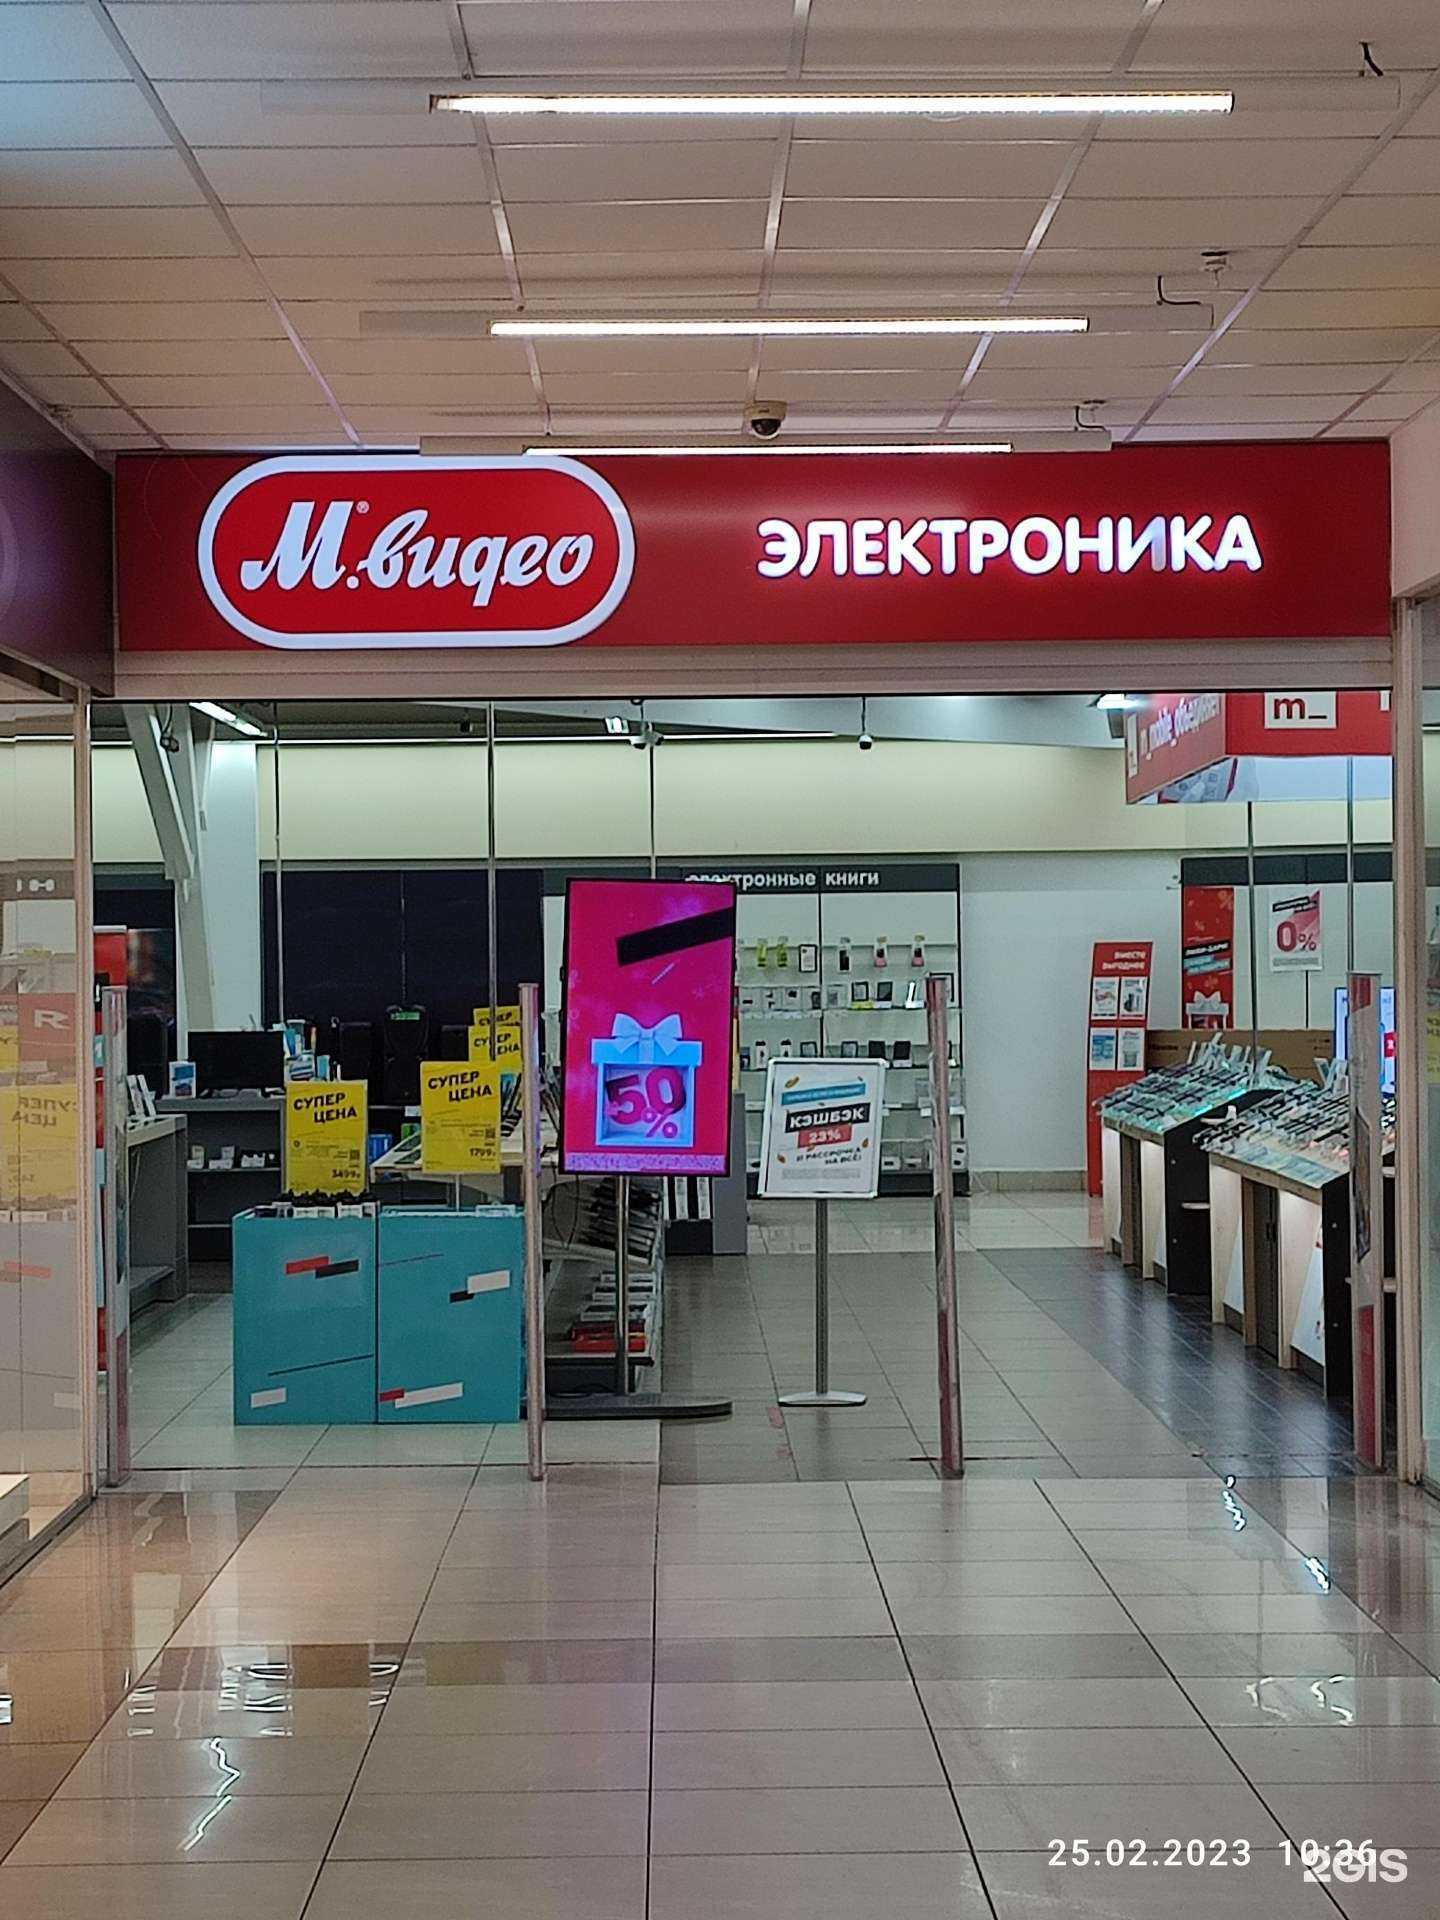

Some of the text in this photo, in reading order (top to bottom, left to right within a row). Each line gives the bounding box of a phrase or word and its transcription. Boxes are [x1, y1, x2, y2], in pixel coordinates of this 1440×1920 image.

[757, 514, 1263, 577] ЭЛЕКТРОНИКА
[825, 870, 879, 886] книги
[1277, 921, 1317, 952] 0%
[473, 1032, 512, 1048] СУЕР
[428, 1071, 480, 1090] СУПЕР
[293, 1092, 346, 1110] СУПЕР
[448, 1085, 492, 1102] ЦЕНА
[313, 1106, 357, 1123] ЦЕНА
[789, 1107, 864, 1129] КЭШБЭК
